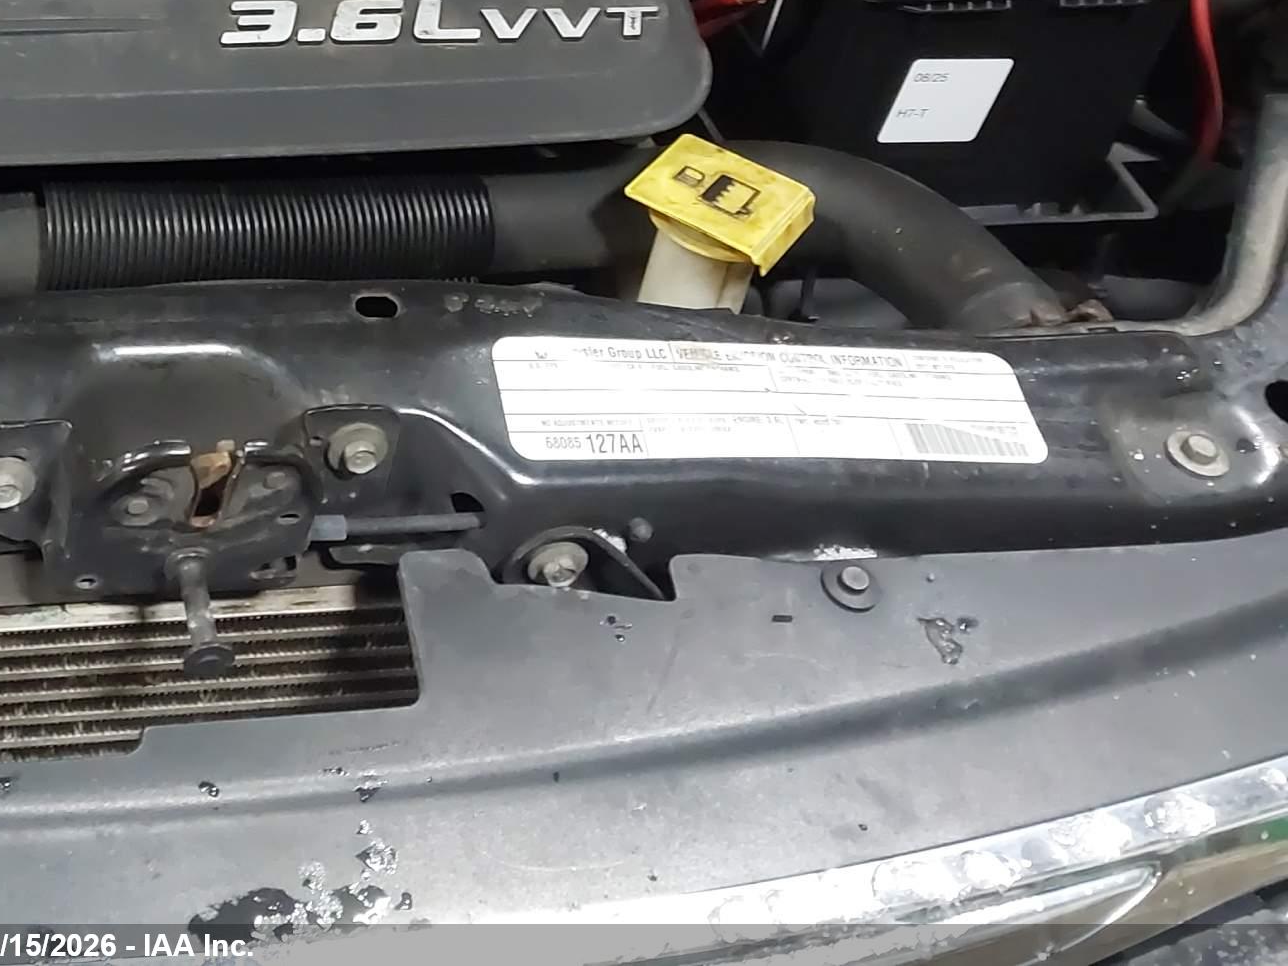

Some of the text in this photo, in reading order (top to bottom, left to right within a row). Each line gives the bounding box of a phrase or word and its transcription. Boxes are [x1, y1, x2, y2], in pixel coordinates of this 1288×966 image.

[607, 347, 642, 359] Group
[645, 347, 667, 360] LLC
[586, 433, 644, 454] 127AA
